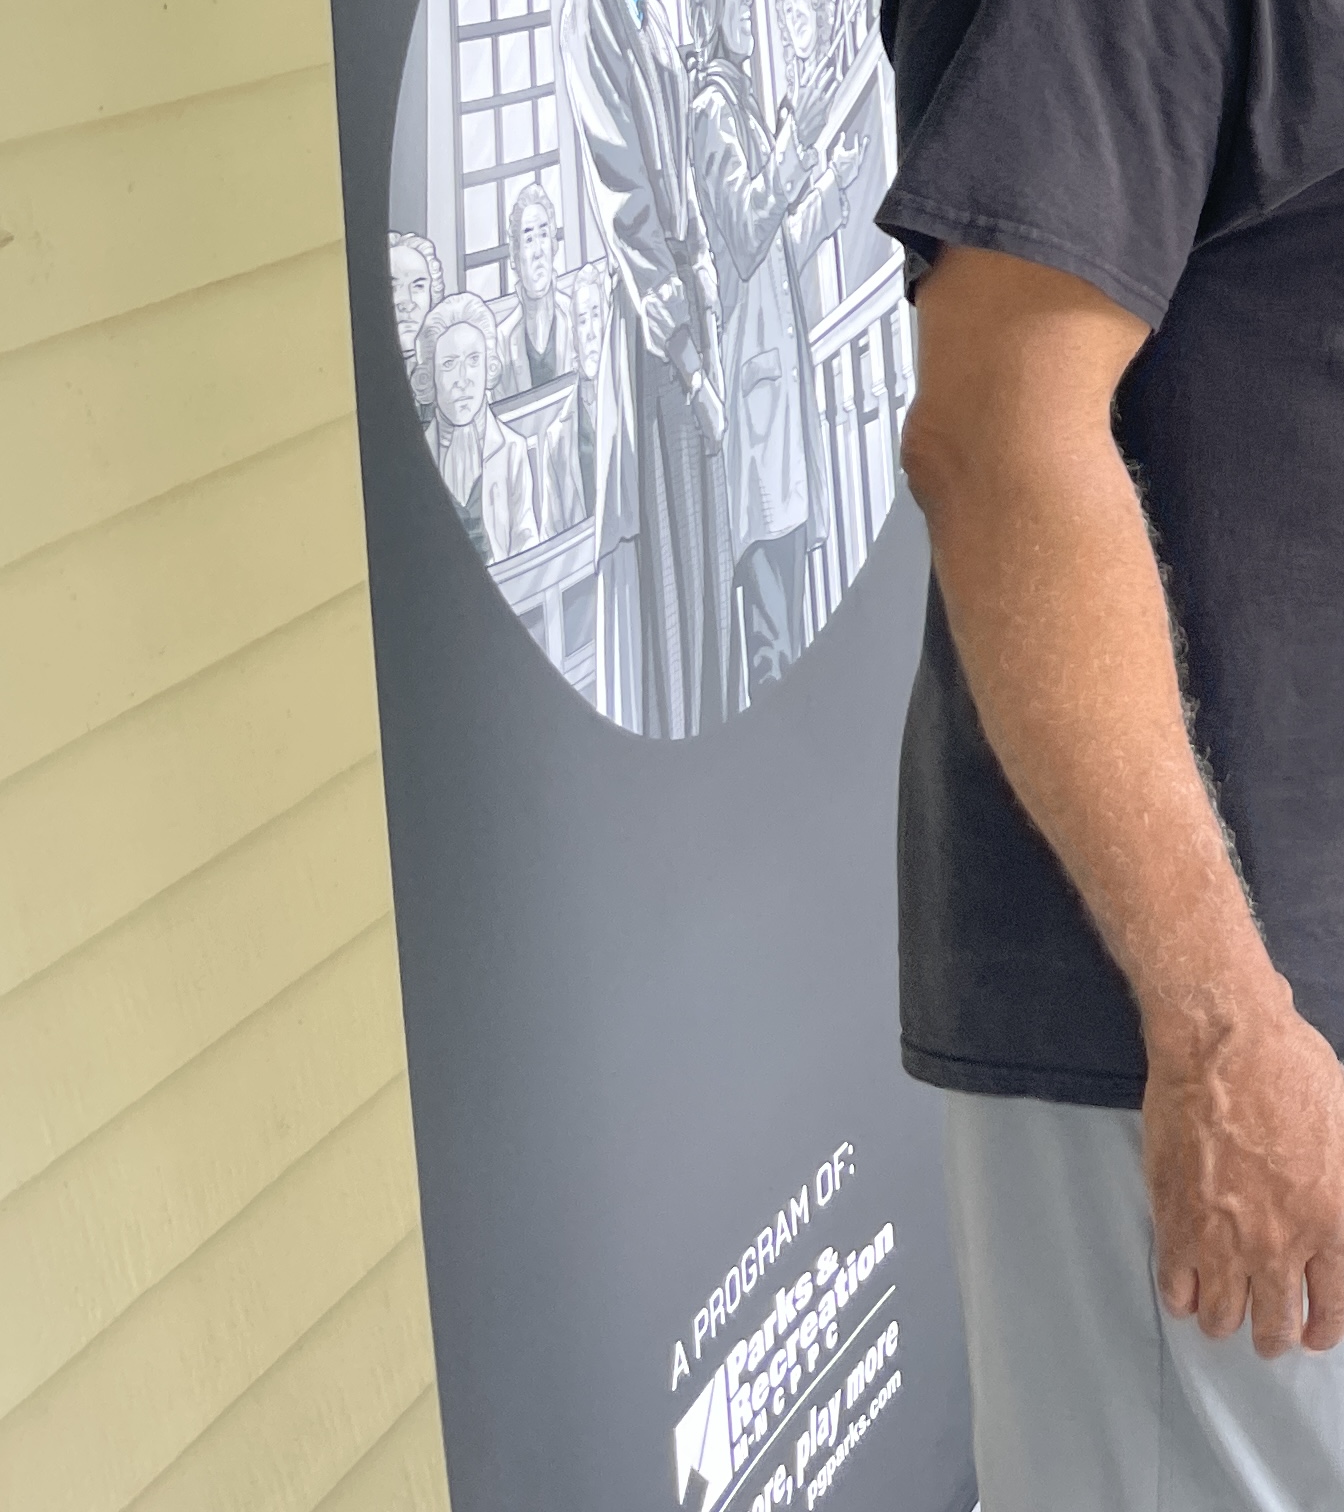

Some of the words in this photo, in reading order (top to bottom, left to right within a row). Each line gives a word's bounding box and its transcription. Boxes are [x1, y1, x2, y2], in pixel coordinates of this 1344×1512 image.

[672, 1341, 690, 1391] A
[693, 1184, 810, 1359] PROGRAM
[815, 1141, 856, 1207] OF:
[726, 1272, 813, 1399] Parks
[816, 1246, 839, 1286] &
[730, 1222, 895, 1443] Recreation
[796, 1388, 842, 1488] play
[847, 1320, 899, 1409] more
[807, 1370, 902, 1511] pgparks.com
